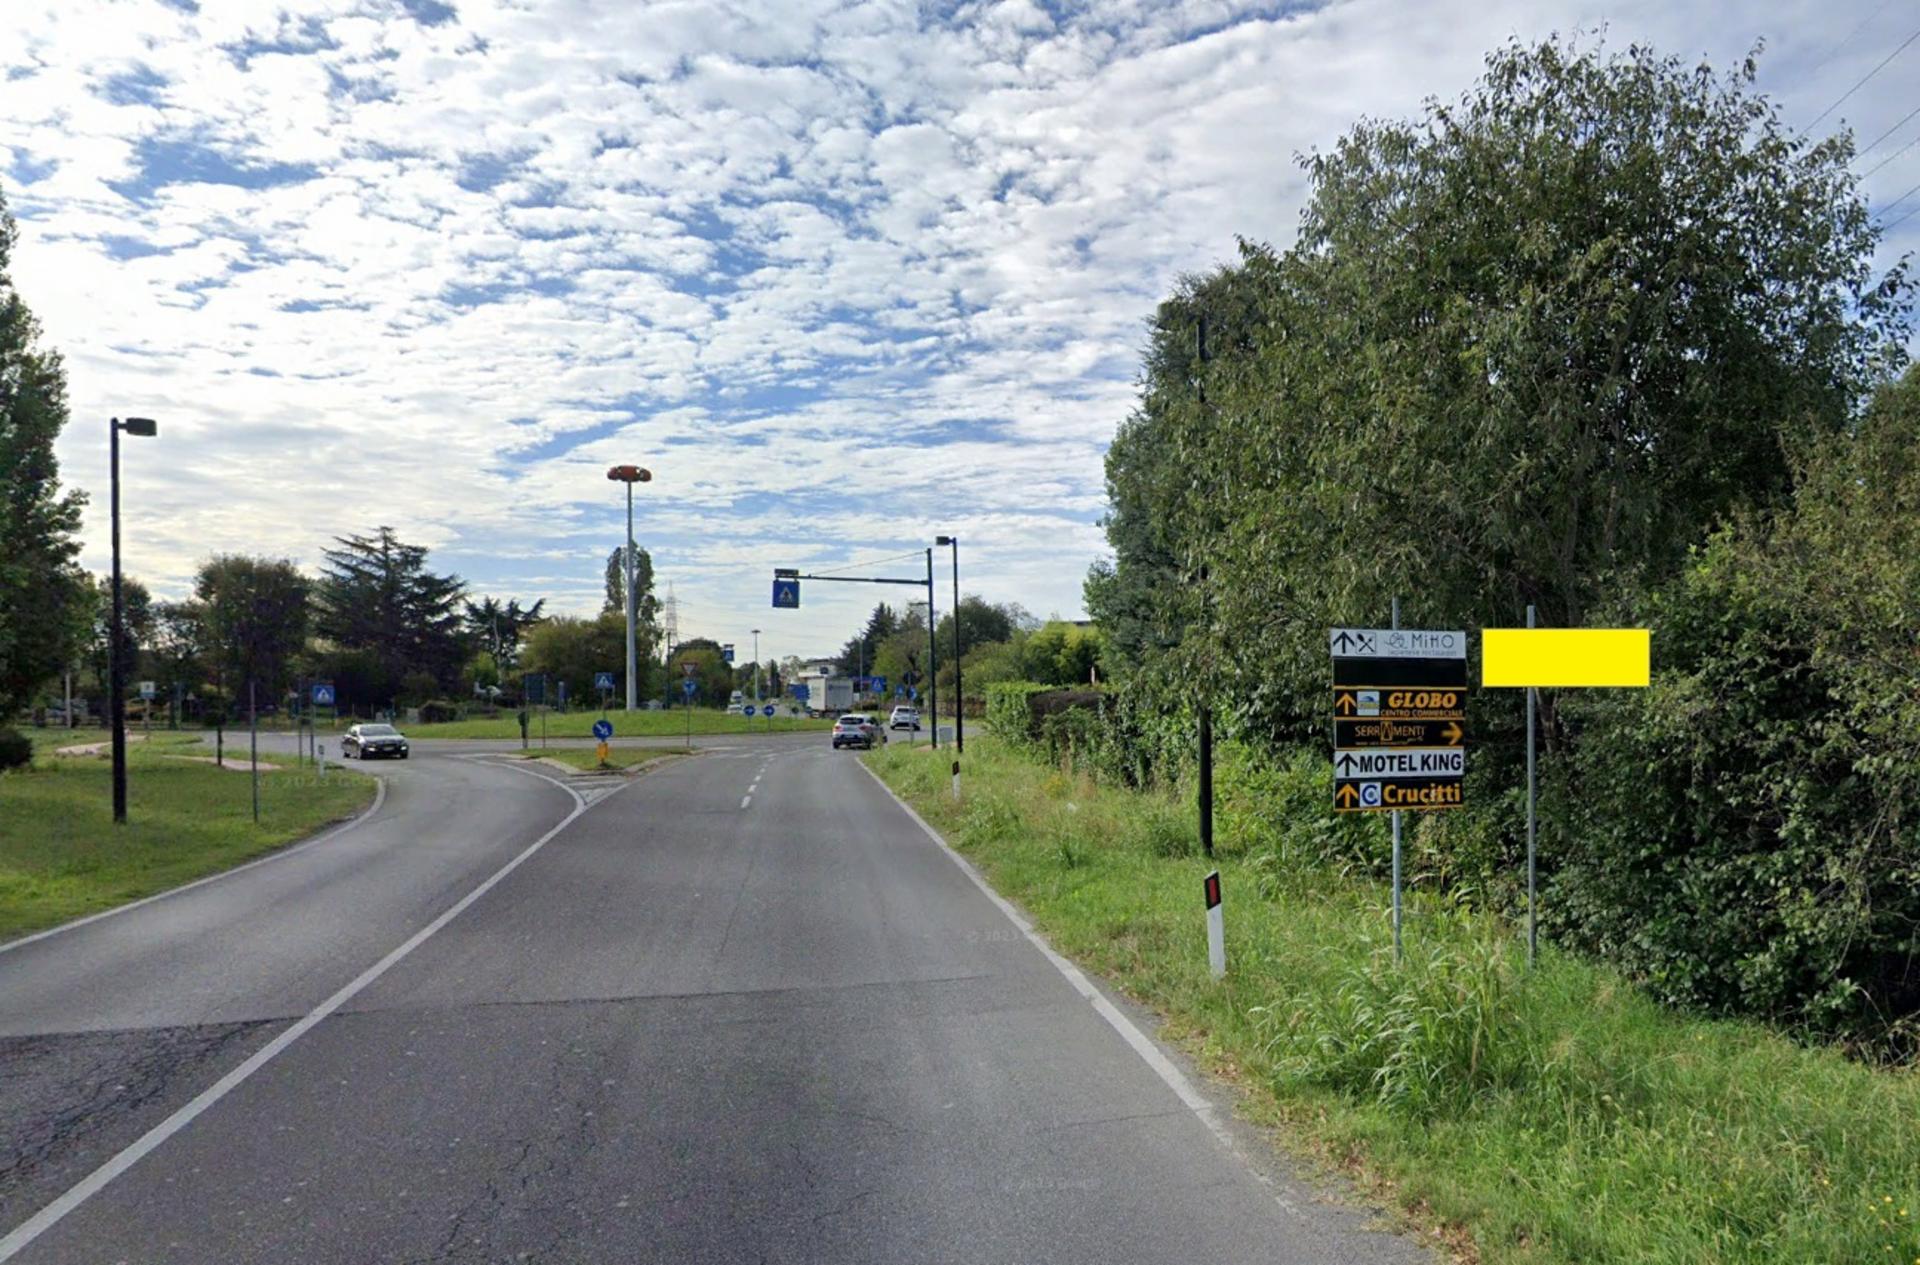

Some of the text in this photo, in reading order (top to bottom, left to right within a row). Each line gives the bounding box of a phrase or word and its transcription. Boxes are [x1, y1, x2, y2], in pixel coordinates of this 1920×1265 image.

[1388, 692, 1457, 708] GLOBO
[1381, 709, 1463, 718] CENTRO COMMERCIALE
[1355, 722, 1425, 739] SERRAMENTI
[1360, 754, 1461, 772] MOTEL KING
[1383, 783, 1460, 803] Crucitti
